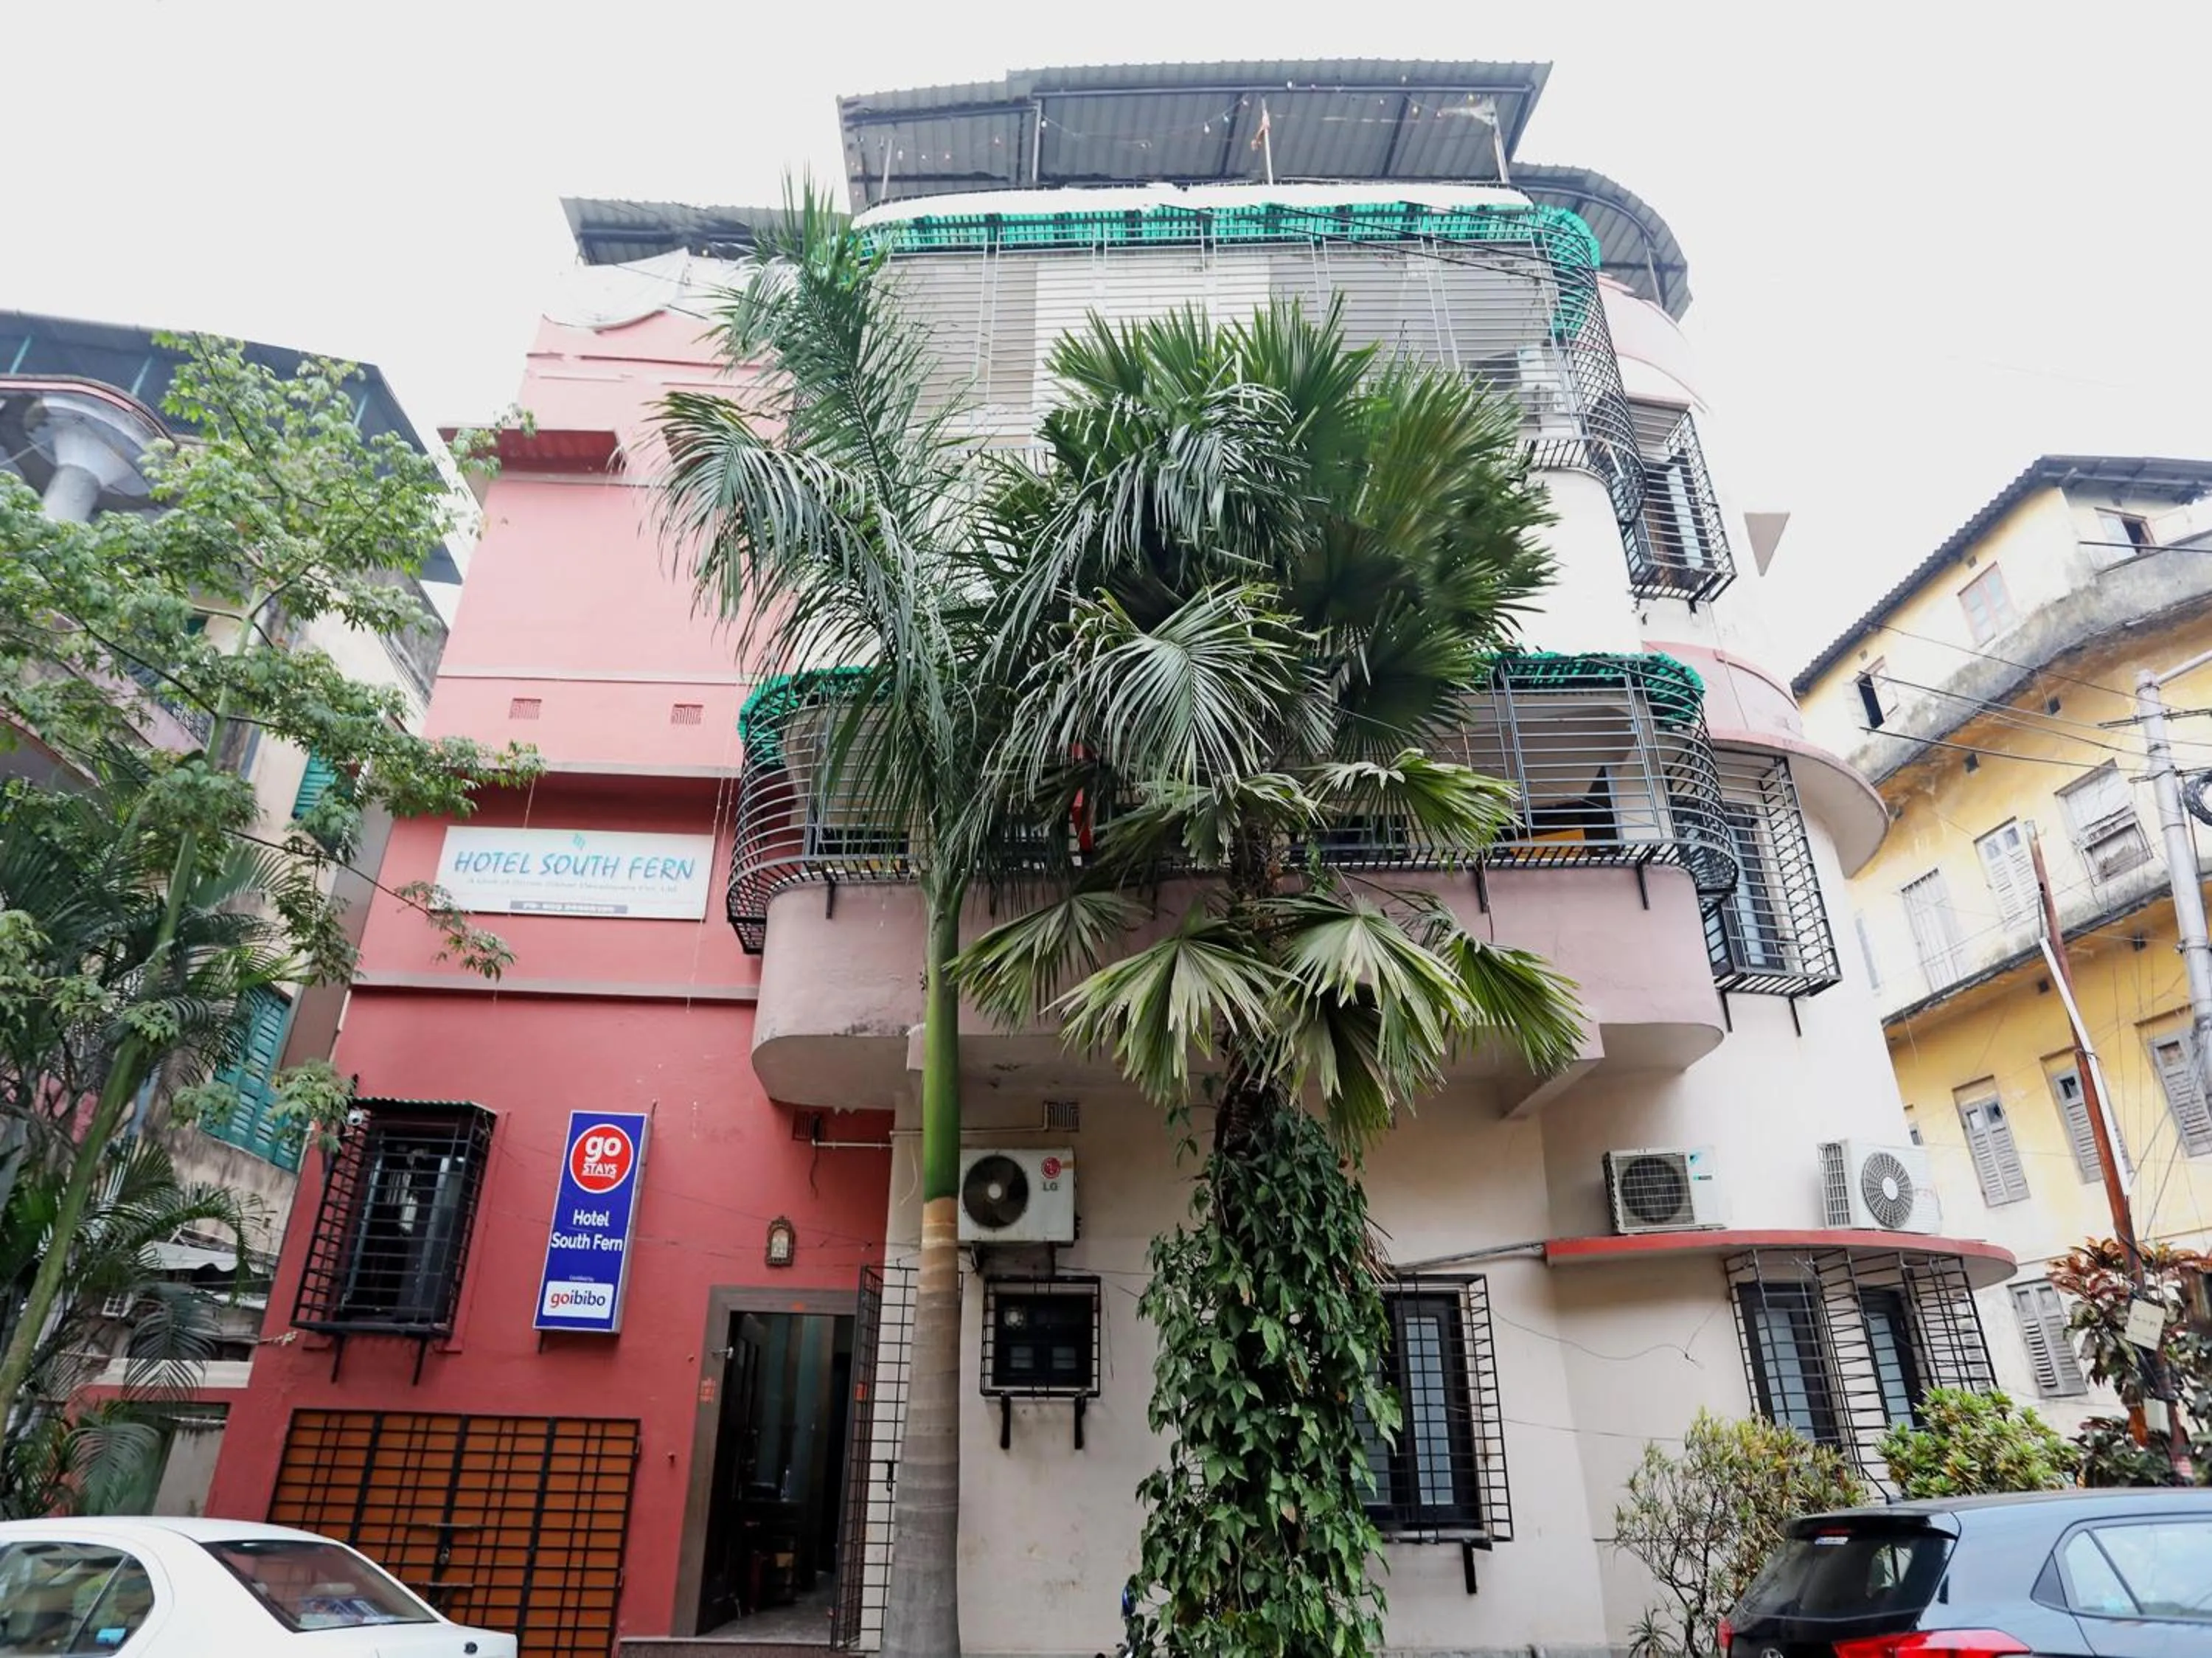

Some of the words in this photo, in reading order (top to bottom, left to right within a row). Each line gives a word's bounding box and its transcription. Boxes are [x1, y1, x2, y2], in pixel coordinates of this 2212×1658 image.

[455, 851, 530, 875] HOTEL
[539, 853, 619, 878] SOUTH
[627, 856, 695, 881] FERN
[585, 1136, 622, 1163] go
[582, 1163, 617, 1176] STAYS
[1043, 1182, 1059, 1192] LG
[573, 1209, 610, 1227] Hotel
[551, 1232, 591, 1249] South
[592, 1234, 623, 1252] Fern
[549, 1289, 605, 1308] goibibo
